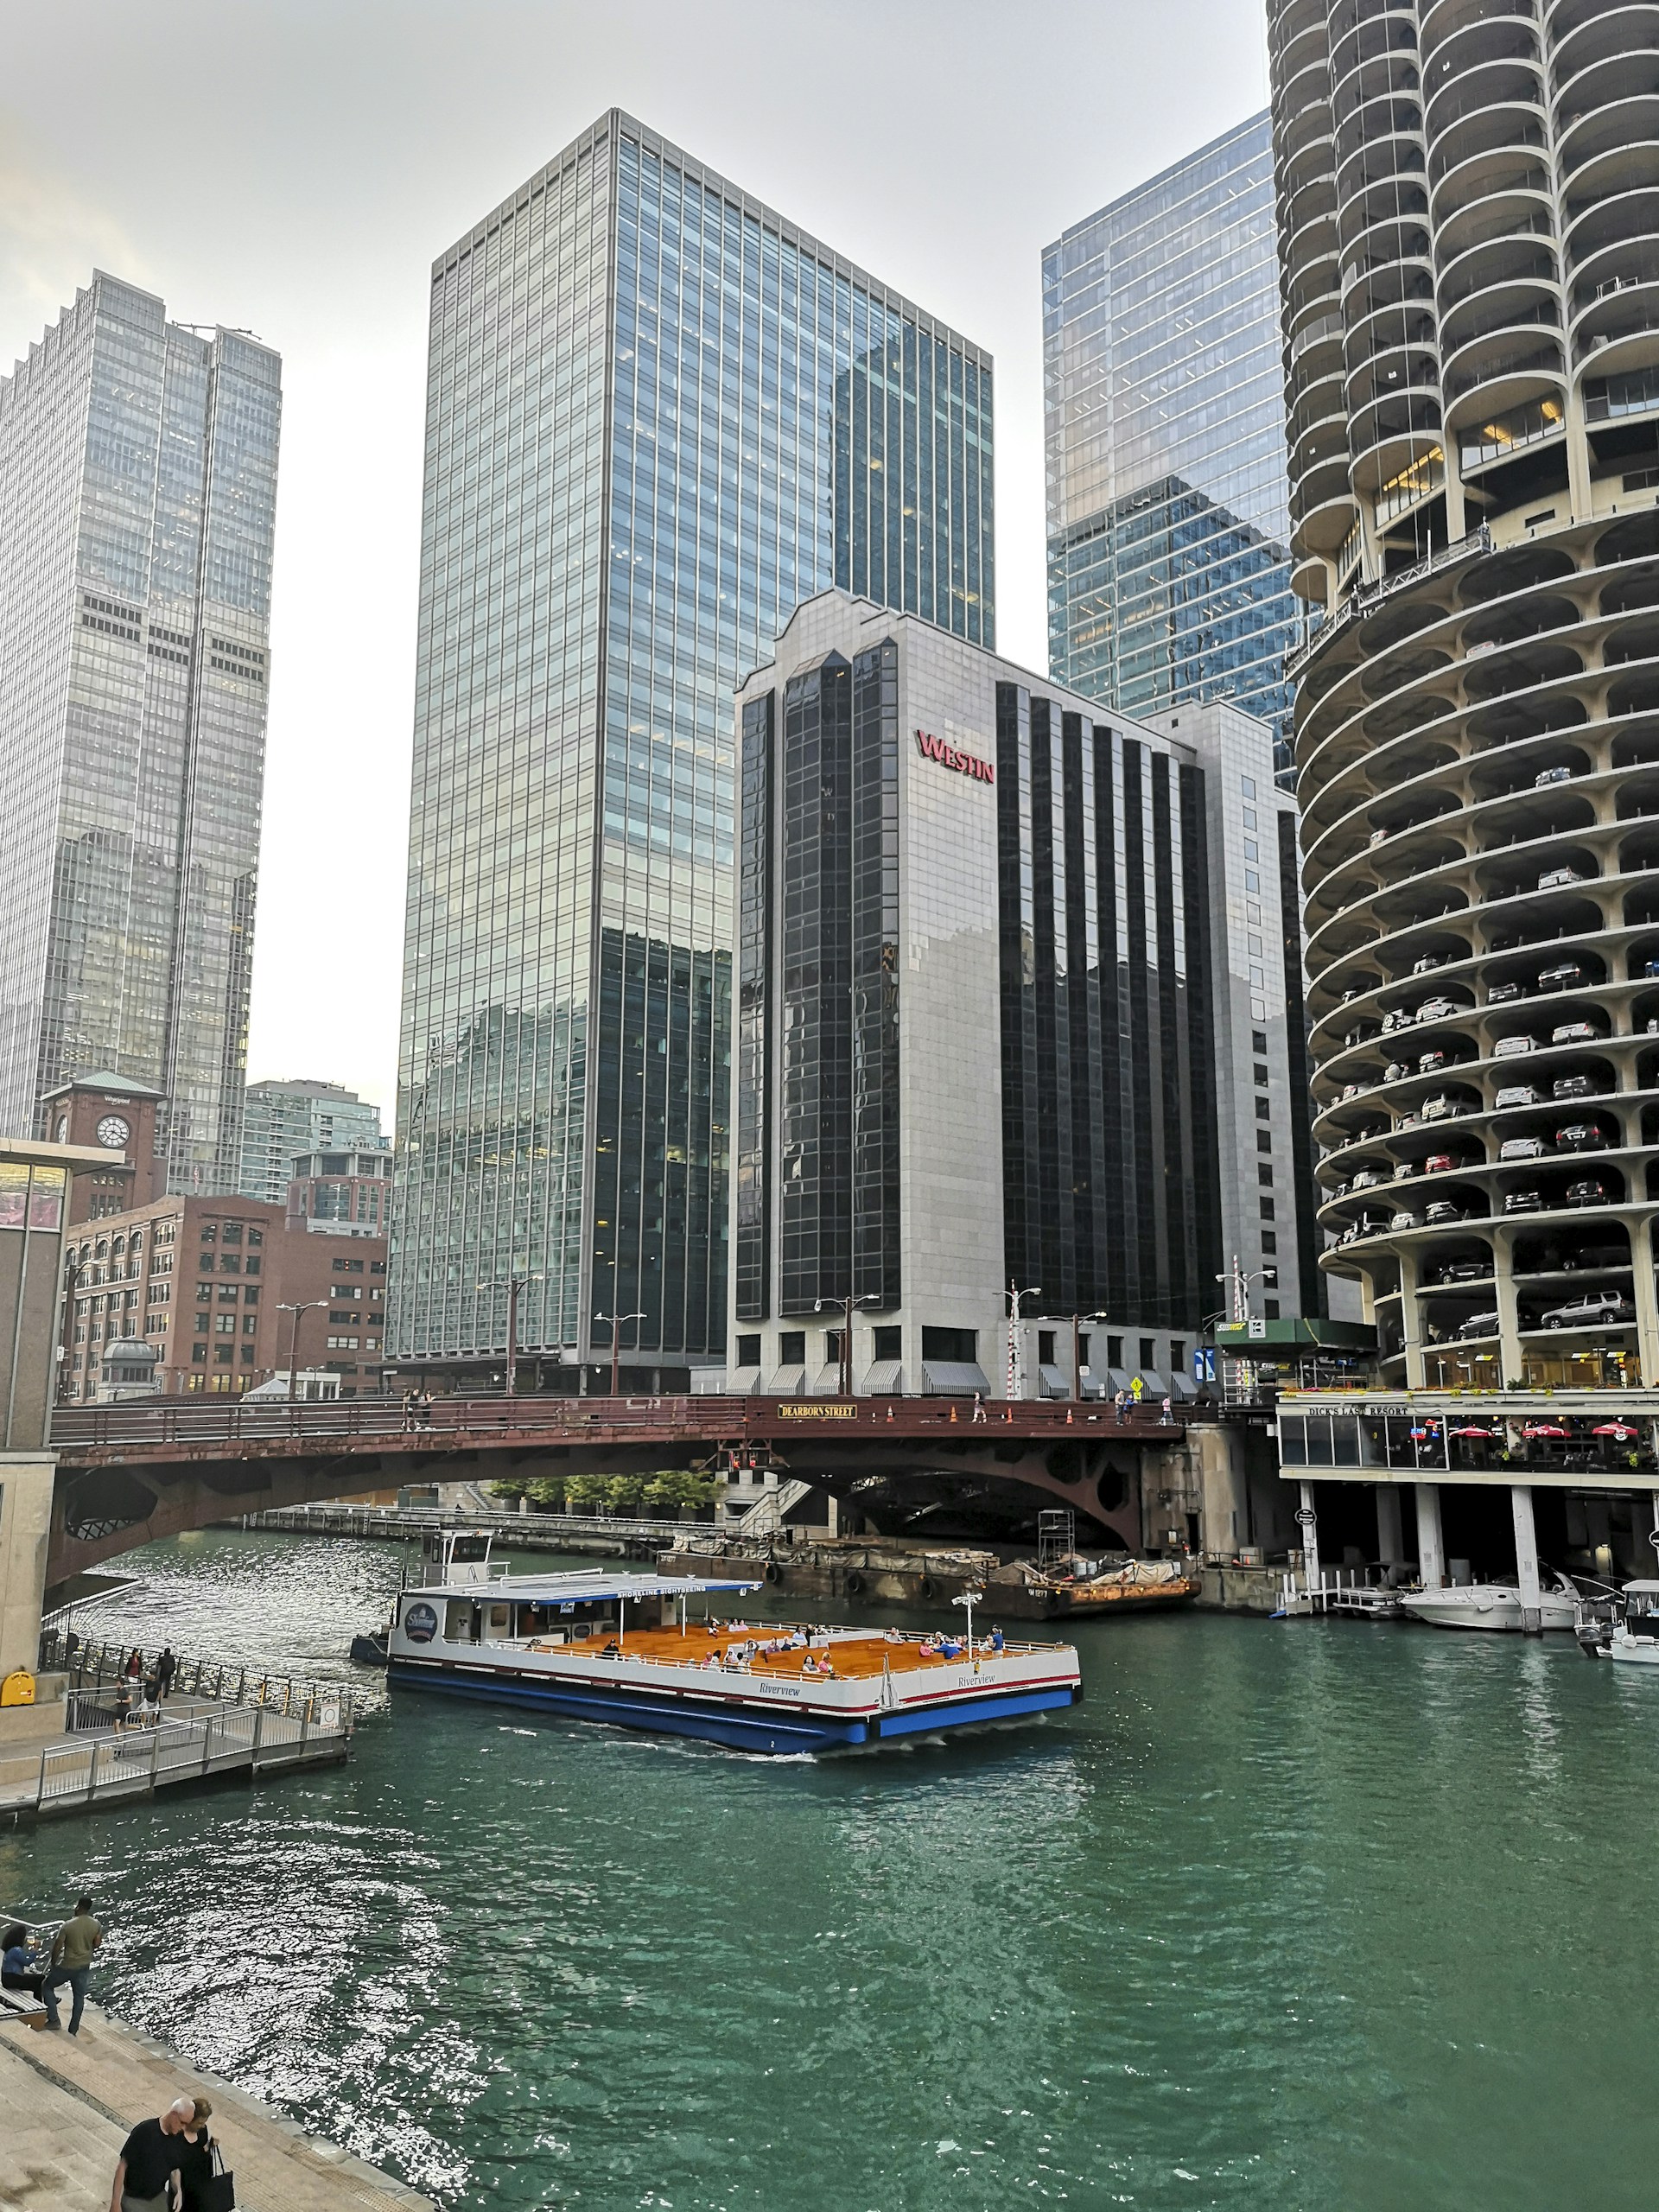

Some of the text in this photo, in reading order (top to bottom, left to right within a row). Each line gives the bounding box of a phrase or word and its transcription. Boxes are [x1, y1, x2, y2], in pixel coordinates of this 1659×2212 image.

[916, 729, 995, 784] WESTIN
[104, 1095, 130, 1105] Whirlpool
[782, 1406, 853, 1417] DEARBORN STREET
[617, 1586, 706, 1599] SHORELINE SIGHTSEEING
[958, 1674, 995, 1688] Riverview
[760, 1682, 801, 1696] Riverview
